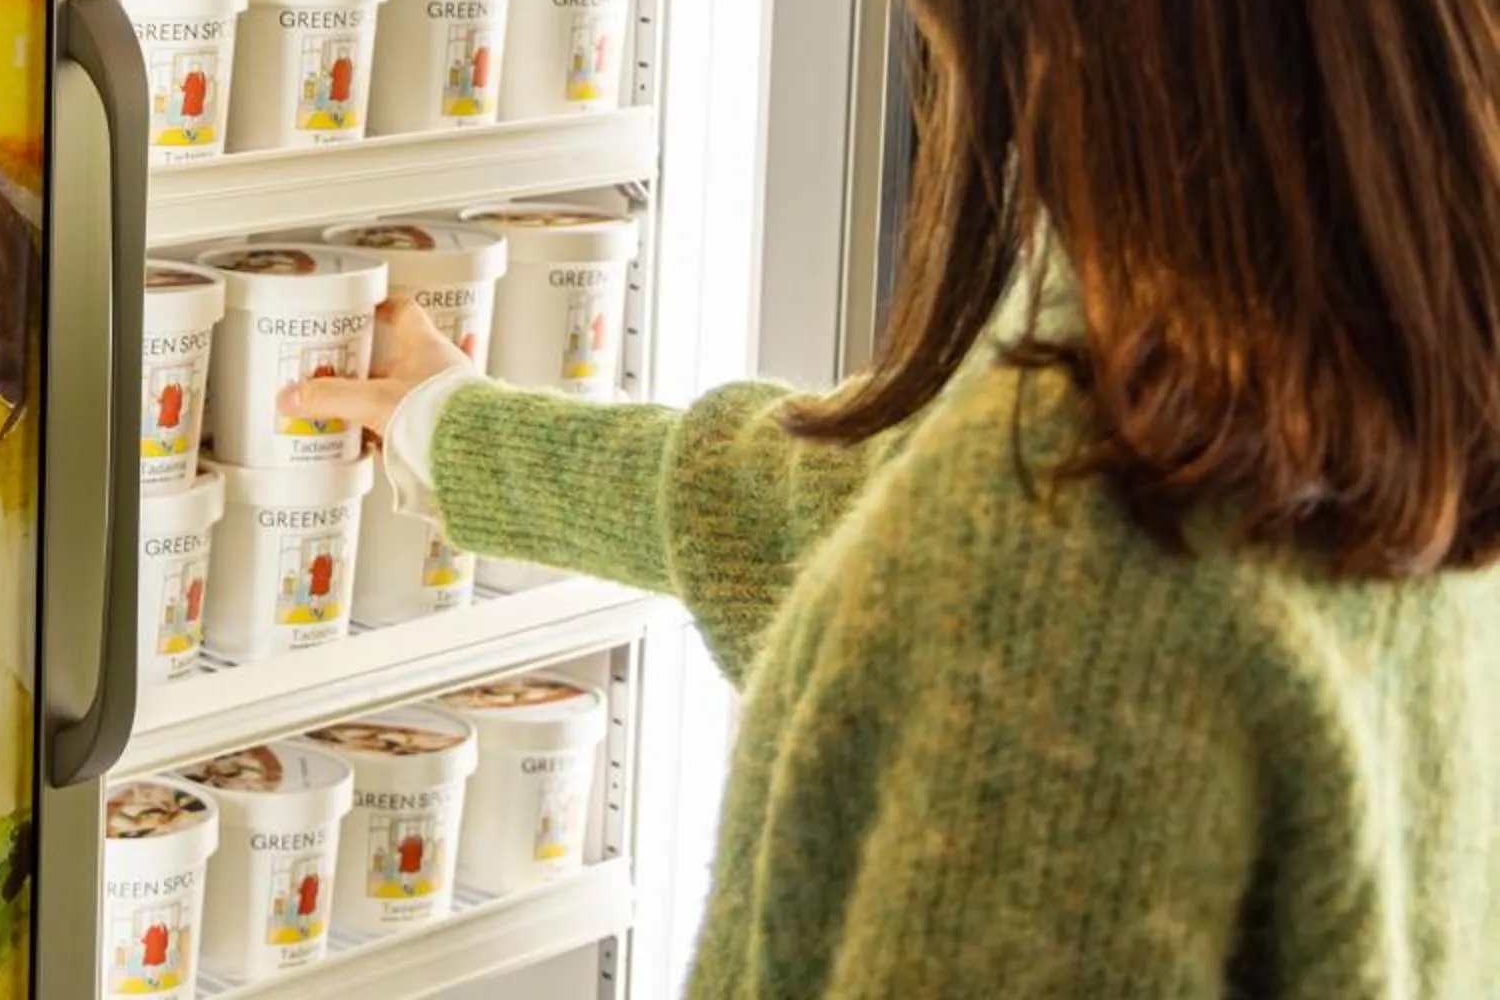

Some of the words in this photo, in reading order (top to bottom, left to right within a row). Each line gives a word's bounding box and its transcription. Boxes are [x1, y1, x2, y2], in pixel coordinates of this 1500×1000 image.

[427, 1, 488, 19] GREEN
[279, 11, 347, 29] GREEN
[133, 22, 197, 41] GREEN
[415, 289, 476, 308] GREEN
[257, 317, 327, 337] GREEN
[259, 509, 326, 528] GREEN
[353, 790, 415, 810] GREEN
[251, 833, 316, 851] GREEN
[107, 880, 159, 898] REEN
